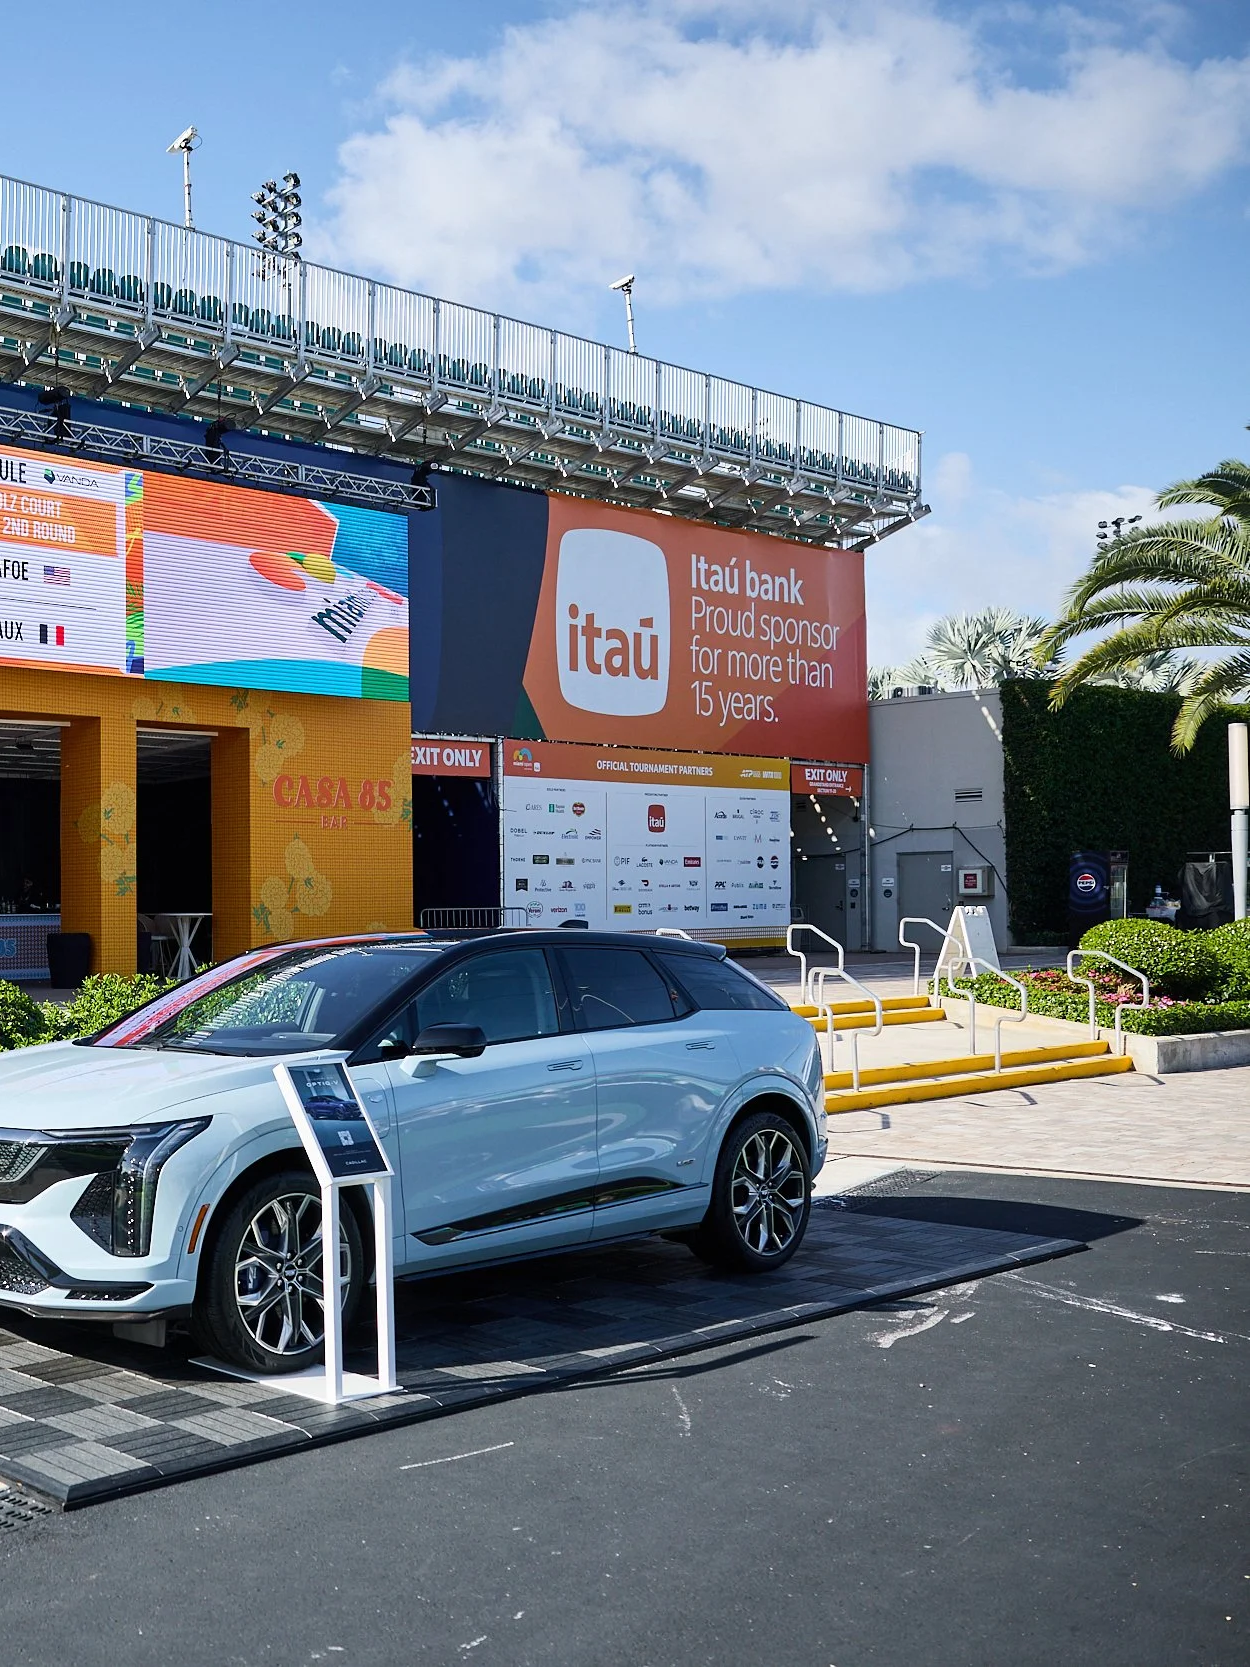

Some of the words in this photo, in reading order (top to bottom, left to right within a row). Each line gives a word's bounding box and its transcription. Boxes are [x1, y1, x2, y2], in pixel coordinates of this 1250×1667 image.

[56, 474, 99, 489] VANDA
[21, 496, 62, 518] COURT
[2, 517, 29, 538] 2ND
[33, 522, 76, 544] ROUND
[690, 553, 739, 595] Itaú
[745, 559, 804, 606] bank
[691, 596, 755, 640] Proud
[760, 613, 839, 651] sponsor
[568, 603, 659, 681] itaú
[690, 634, 723, 674] for
[727, 650, 783, 683] more
[787, 649, 833, 689] than
[690, 680, 712, 716] 15
[718, 690, 780, 727] years.
[442, 748, 483, 767] ONLY
[597, 760, 629, 772] OFFICIAL
[630, 762, 678, 774] TOURNAMENT
[679, 765, 713, 776] PARTNERS
[805, 768, 825, 781] EXIT
[826, 770, 848, 783] ONLY
[272, 774, 353, 809] CASA
[358, 778, 393, 811] 85
[321, 815, 348, 829] BAR
[649, 816, 664, 828] itaú
[620, 857, 630, 865] PIF
